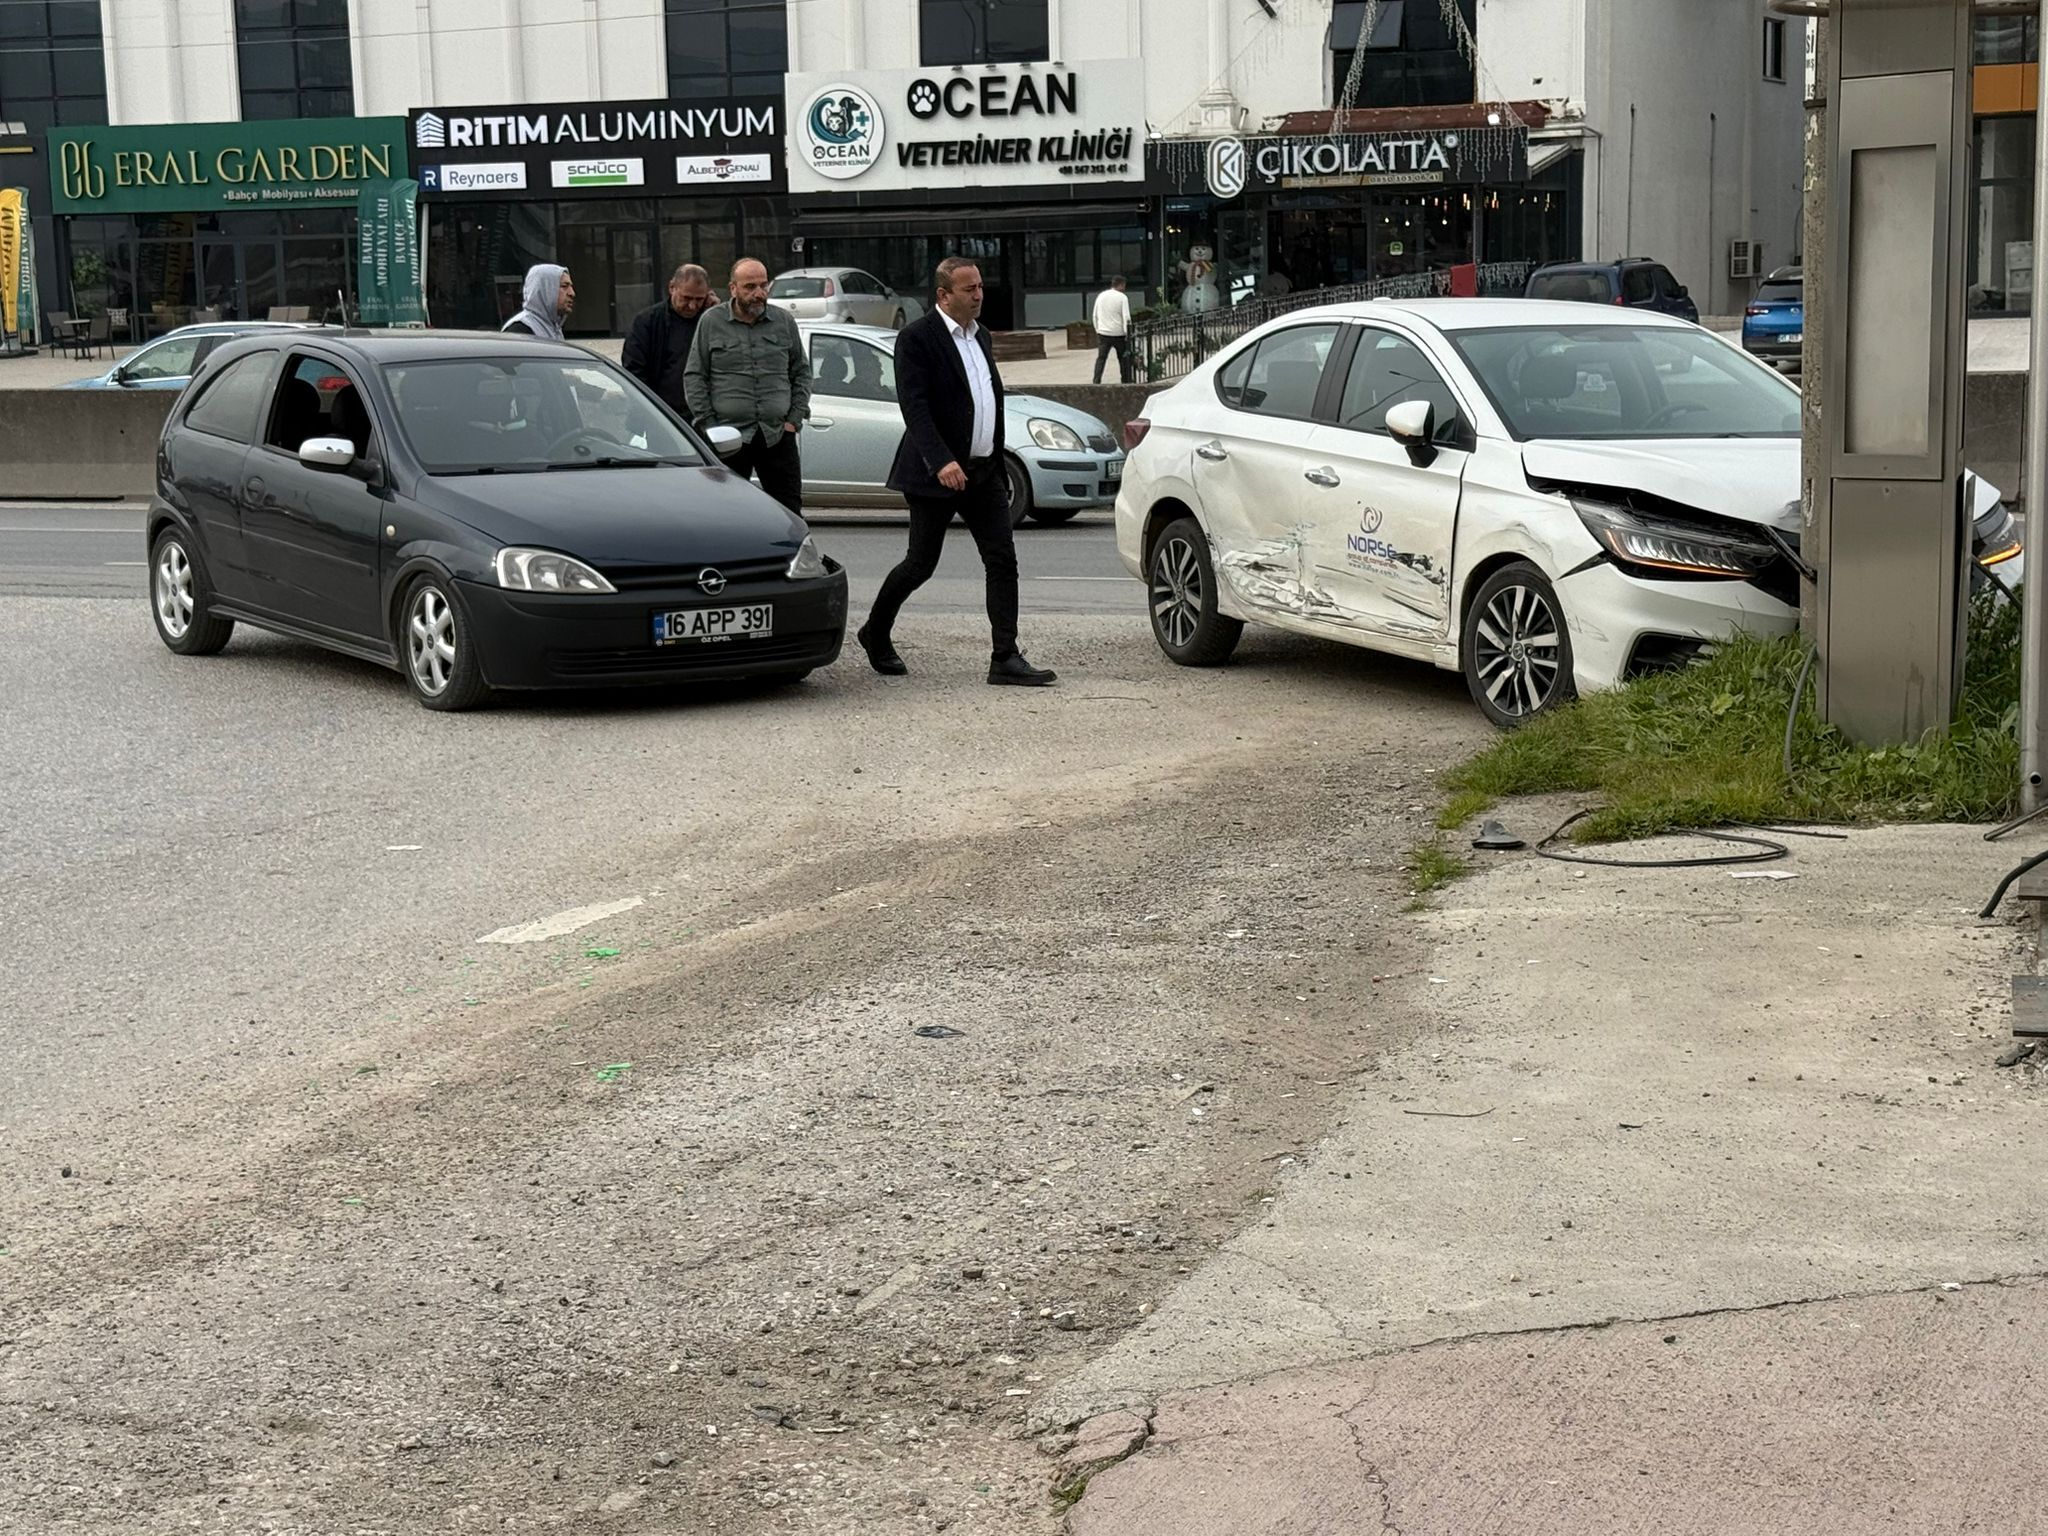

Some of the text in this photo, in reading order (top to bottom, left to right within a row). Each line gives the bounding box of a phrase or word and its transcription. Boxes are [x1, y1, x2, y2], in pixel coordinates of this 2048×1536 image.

[907, 72, 1078, 119] OCEAN
[113, 143, 391, 186] ERAL GARDEN
[813, 145, 870, 159] OCEAN
[897, 127, 1132, 167] VETERİNER KLİNİĞİ
[1256, 139, 1449, 184] ÇİKOLATTA
[449, 171, 519, 187] Reynaers
[1347, 534, 1397, 559] NORSE
[666, 606, 771, 636] 16 APP 391
